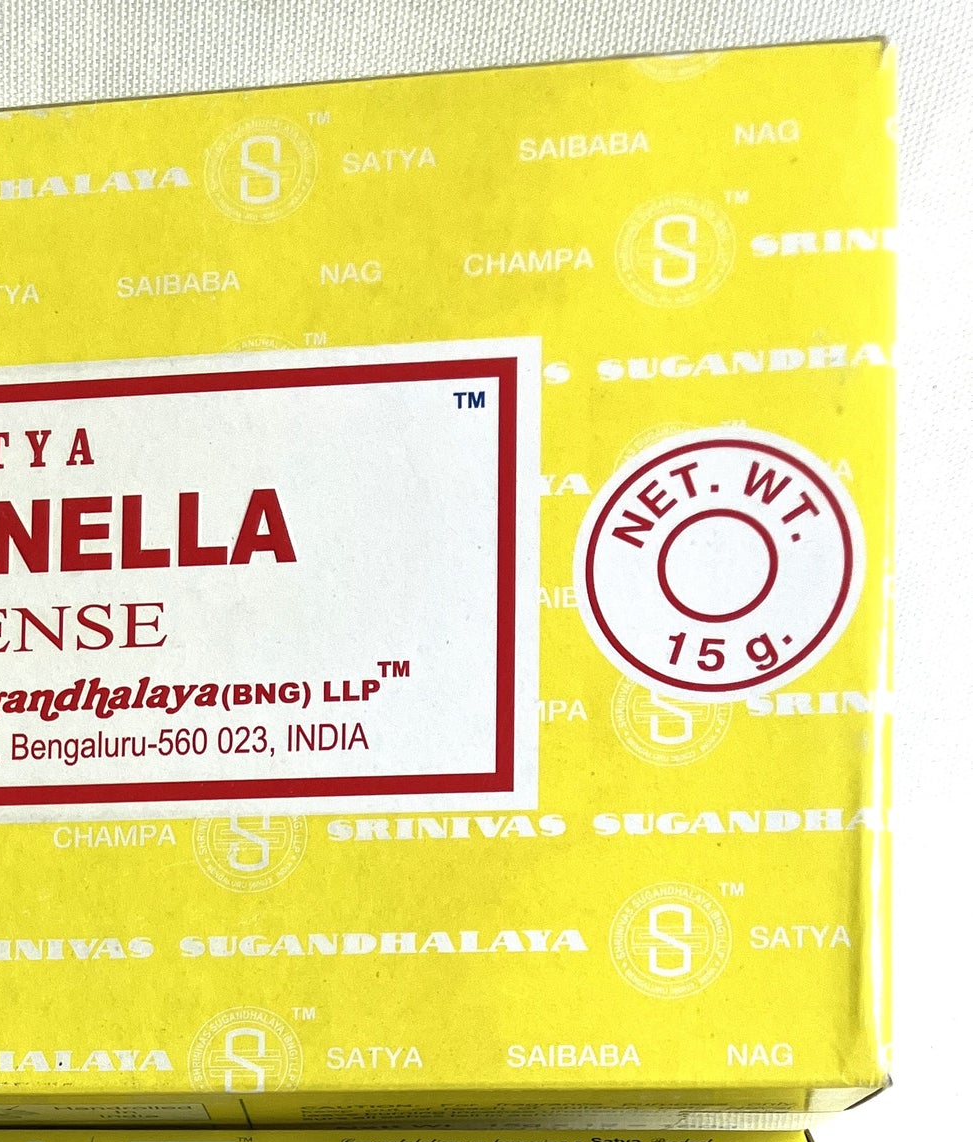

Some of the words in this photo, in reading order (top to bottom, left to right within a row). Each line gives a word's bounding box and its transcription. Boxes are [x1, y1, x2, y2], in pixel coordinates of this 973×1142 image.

[343, 148, 436, 175] SATYA
[519, 132, 649, 162] SAIBABA
[734, 119, 800, 146] NAG
[117, 270, 240, 298] SAIBABA
[321, 261, 381, 284] NAG
[464, 248, 593, 277] CHAMPA
[454, 392, 486, 409] TM
[612, 462, 719, 548] NET.
[744, 461, 820, 541] WT.
[669, 632, 725, 671] 15
[746, 633, 793, 671] g.
[323, 679, 380, 702] LLP
[378, 661, 410, 677] TM
[12, 729, 207, 765] Bengaluru-560
[217, 726, 276, 756] 023,
[287, 723, 369, 751] INDIA
[54, 825, 176, 849] CHAMPA
[328, 815, 566, 840] SRINIVAS
[180, 929, 587, 956] SUGANDHALAYA
[750, 926, 851, 948] SATYA
[327, 1047, 422, 1070] SATYA
[507, 1044, 640, 1067] SAIBABA
[727, 1044, 793, 1066] NAG
